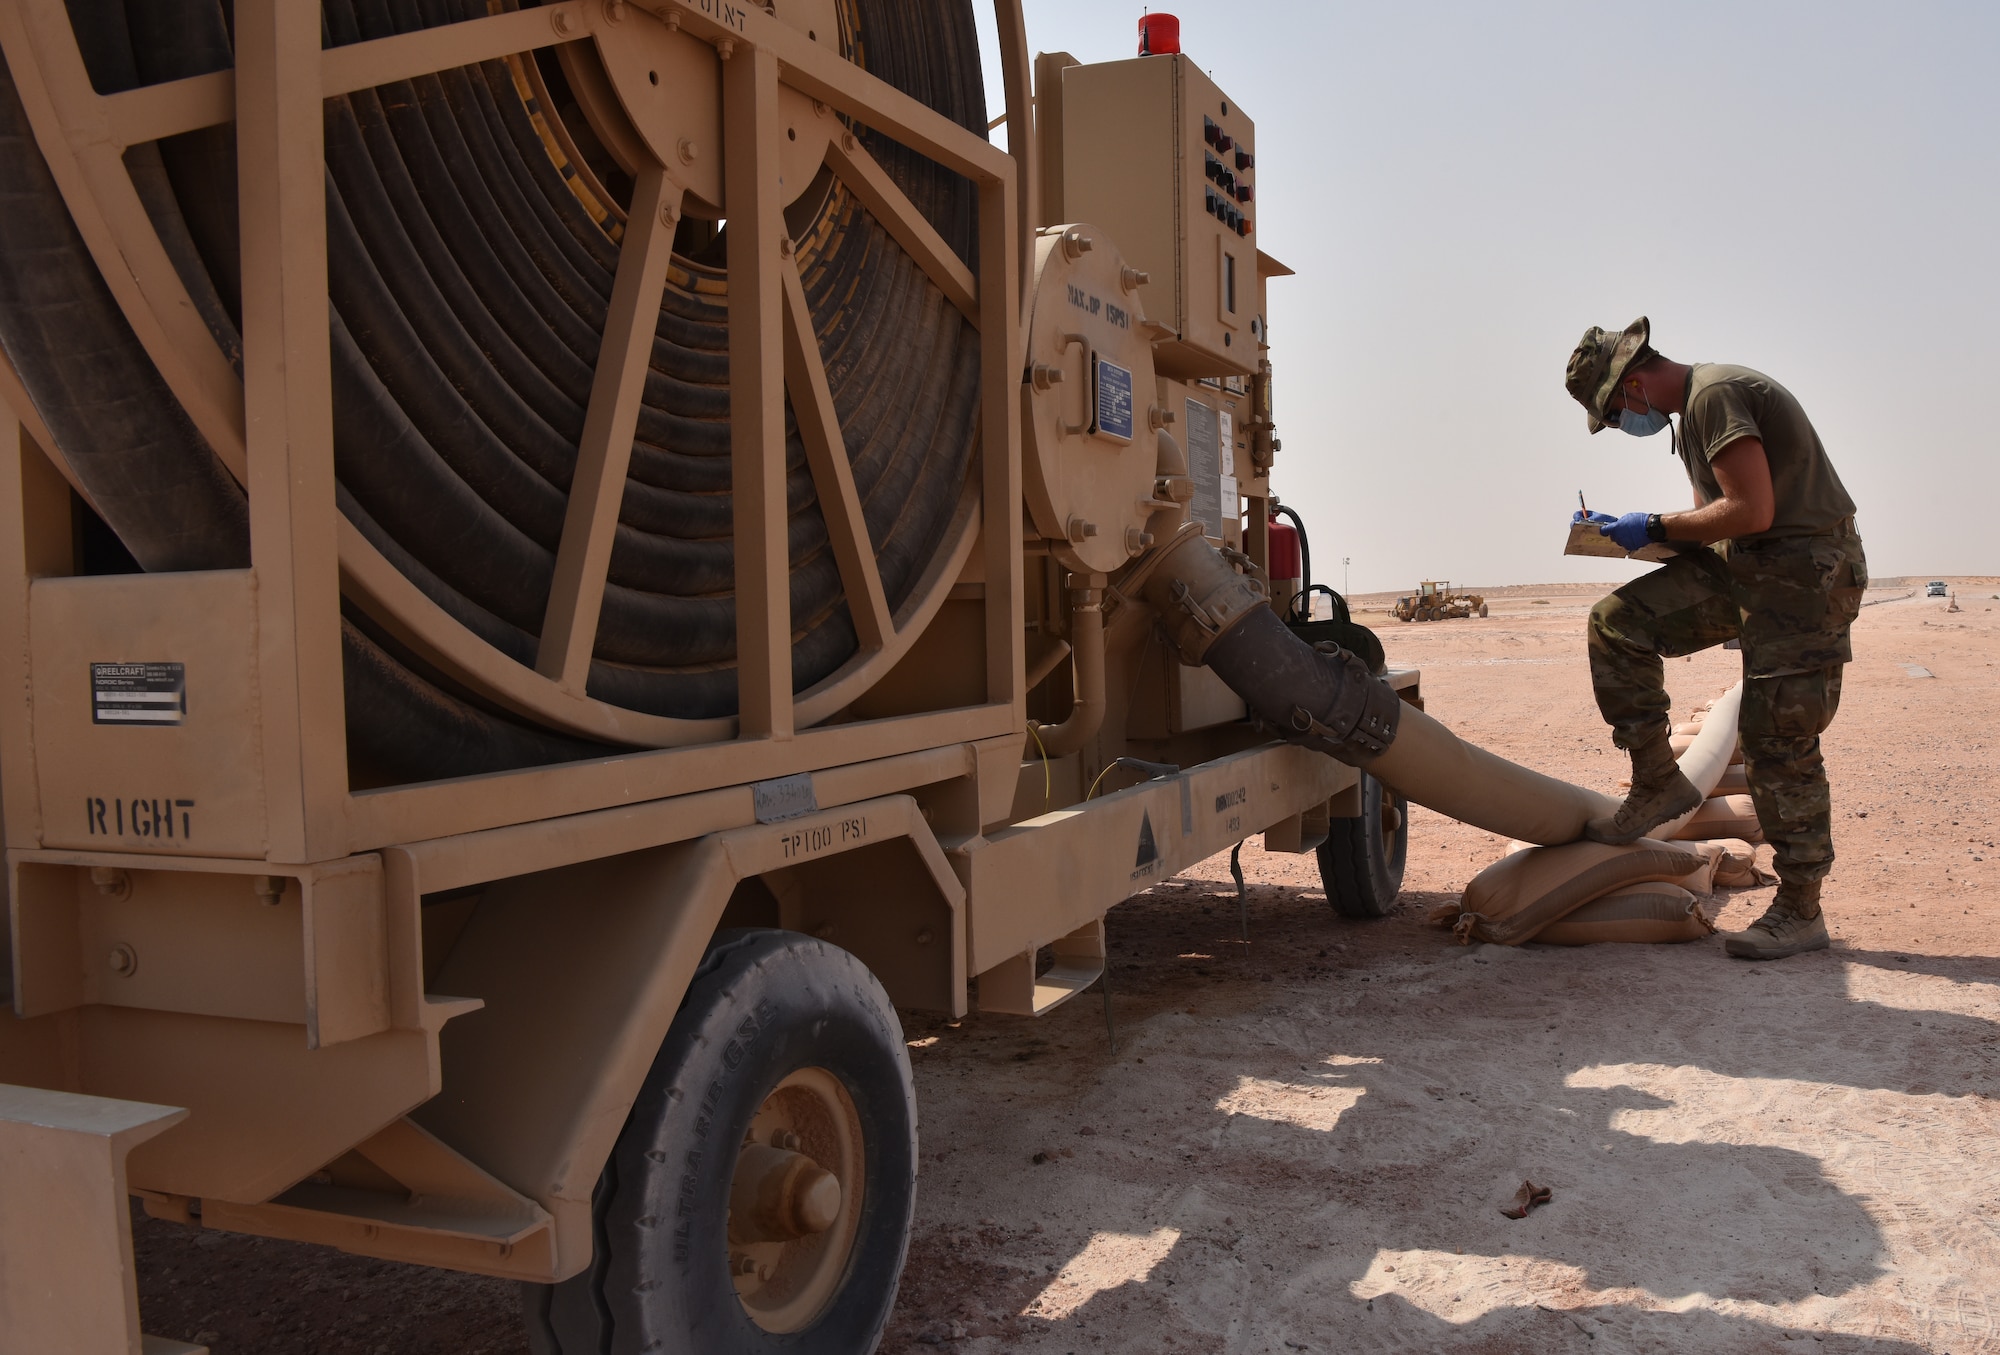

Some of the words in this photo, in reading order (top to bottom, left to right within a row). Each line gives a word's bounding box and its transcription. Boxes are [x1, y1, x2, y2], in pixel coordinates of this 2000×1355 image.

[688, 0, 746, 32] OINT
[102, 666, 144, 676] REELCRAFT
[86, 797, 195, 839] RIGHT
[841, 816, 867, 842] PSI
[675, 1150, 702, 1264] ULTRA
[695, 1080, 725, 1139] RIB
[722, 998, 777, 1072] GSE
